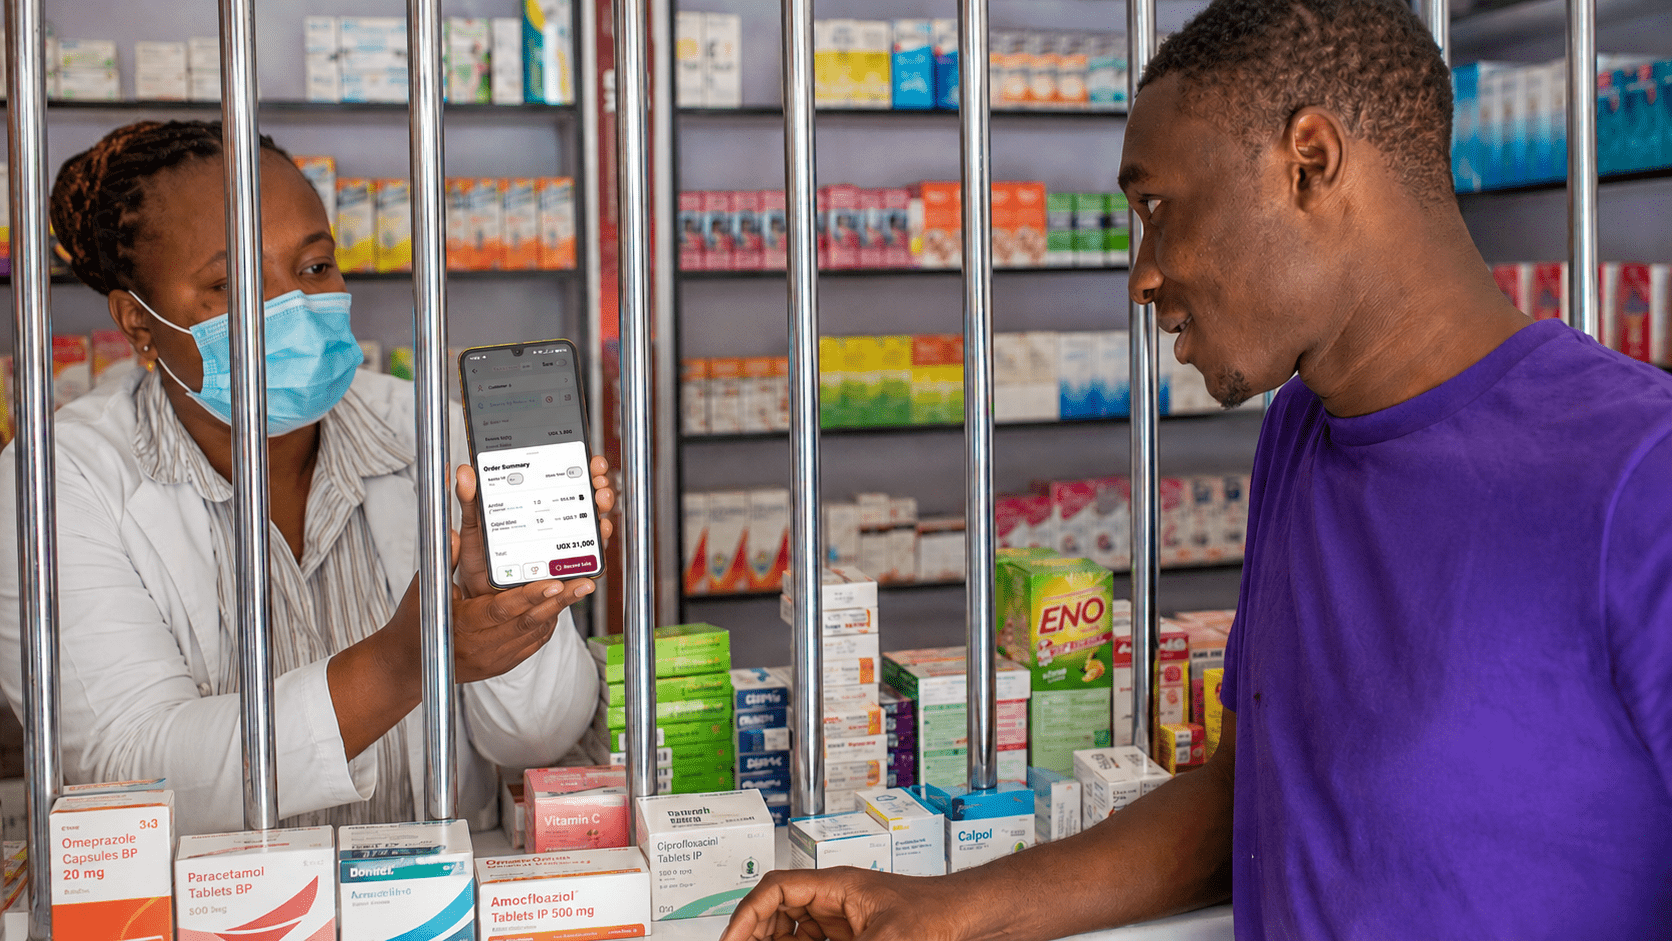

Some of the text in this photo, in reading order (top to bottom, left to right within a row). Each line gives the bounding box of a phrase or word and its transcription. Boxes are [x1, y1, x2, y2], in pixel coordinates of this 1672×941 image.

[502, 462, 530, 470] Summary
[1039, 597, 1105, 635] ENO
[544, 813, 601, 826] Vitamin C
[61, 833, 137, 850] Omeprazole
[958, 828, 993, 843] Calpol
[62, 847, 138, 866] Capsules BP
[657, 850, 703, 864] Tablets IP
[63, 868, 105, 881] 20 mg
[188, 866, 265, 883] Paracetamol
[188, 883, 253, 899] Tablets BP
[491, 906, 595, 923] Tablets IP 500 mg
